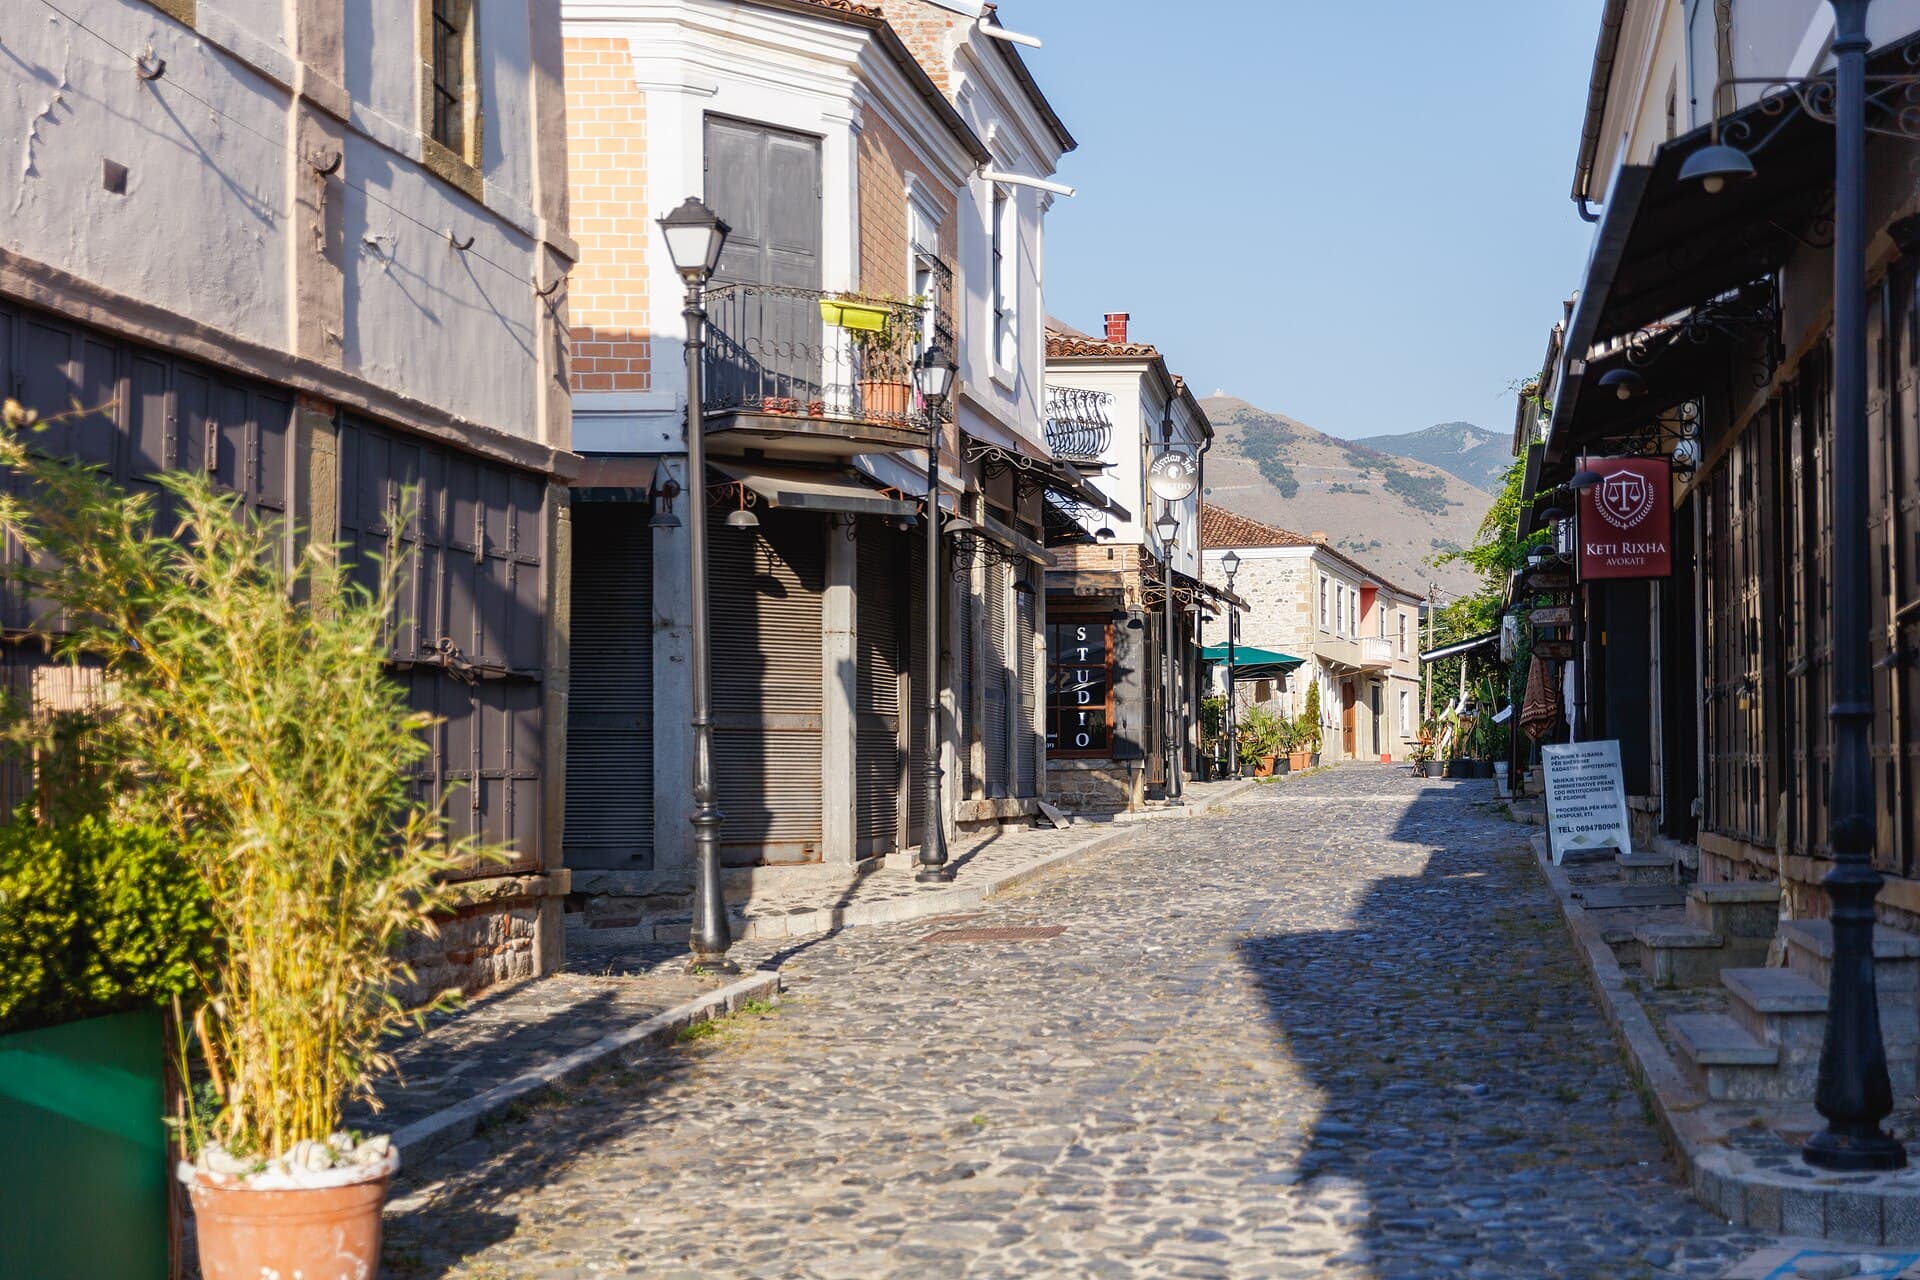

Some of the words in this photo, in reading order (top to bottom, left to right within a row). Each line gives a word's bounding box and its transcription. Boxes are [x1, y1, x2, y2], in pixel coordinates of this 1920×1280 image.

[1181, 456, 1196, 475] Ink
[1586, 543, 1616, 555] KETI
[1622, 542, 1666, 554] RIXHA
[1606, 557, 1645, 566] AVOKATE
[1076, 627, 1090, 747] STUDIO
